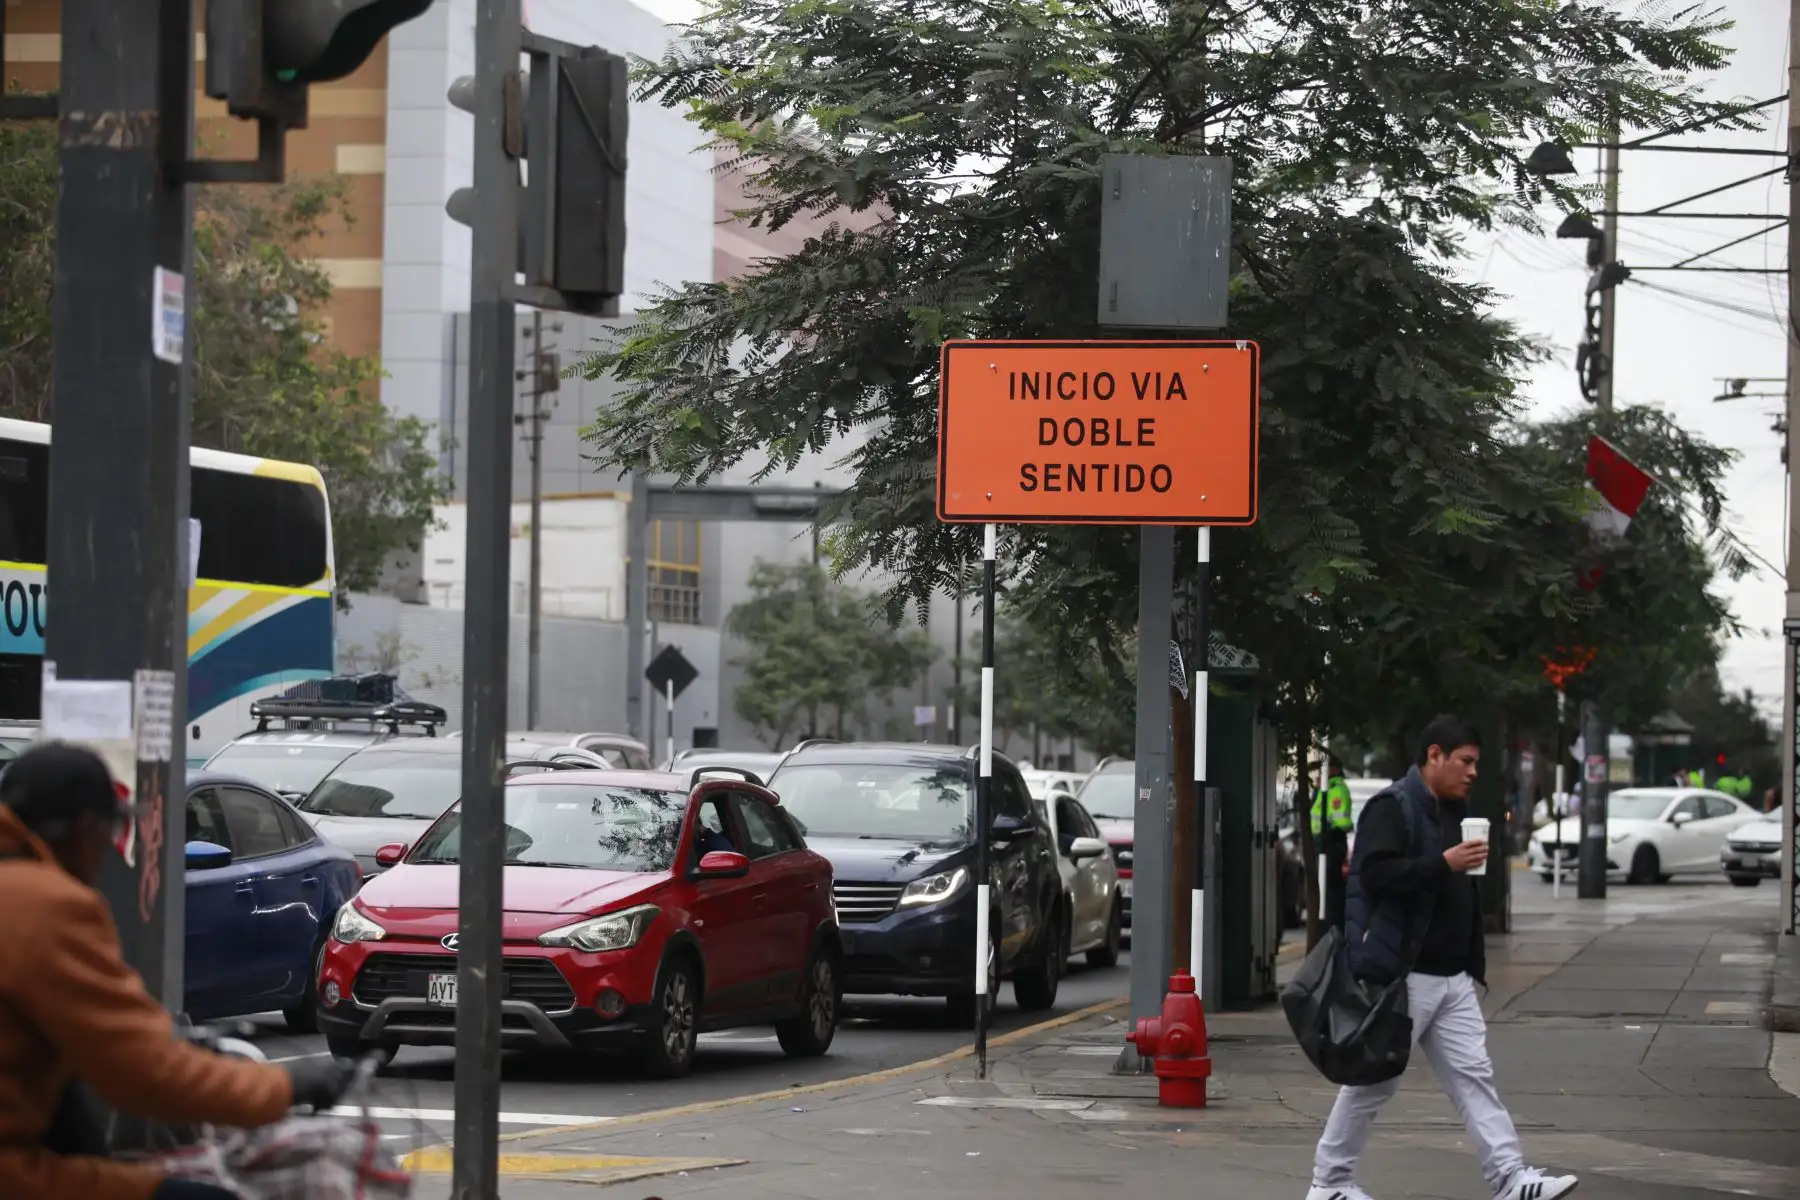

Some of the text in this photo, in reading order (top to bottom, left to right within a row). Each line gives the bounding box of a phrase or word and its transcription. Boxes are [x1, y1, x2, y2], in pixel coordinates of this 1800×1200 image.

[1009, 371, 1188, 400] INICIO VIA
[1038, 417, 1156, 447] DOBLE
[1019, 462, 1173, 493] SENTIDO
[430, 982, 458, 1000] AYT
